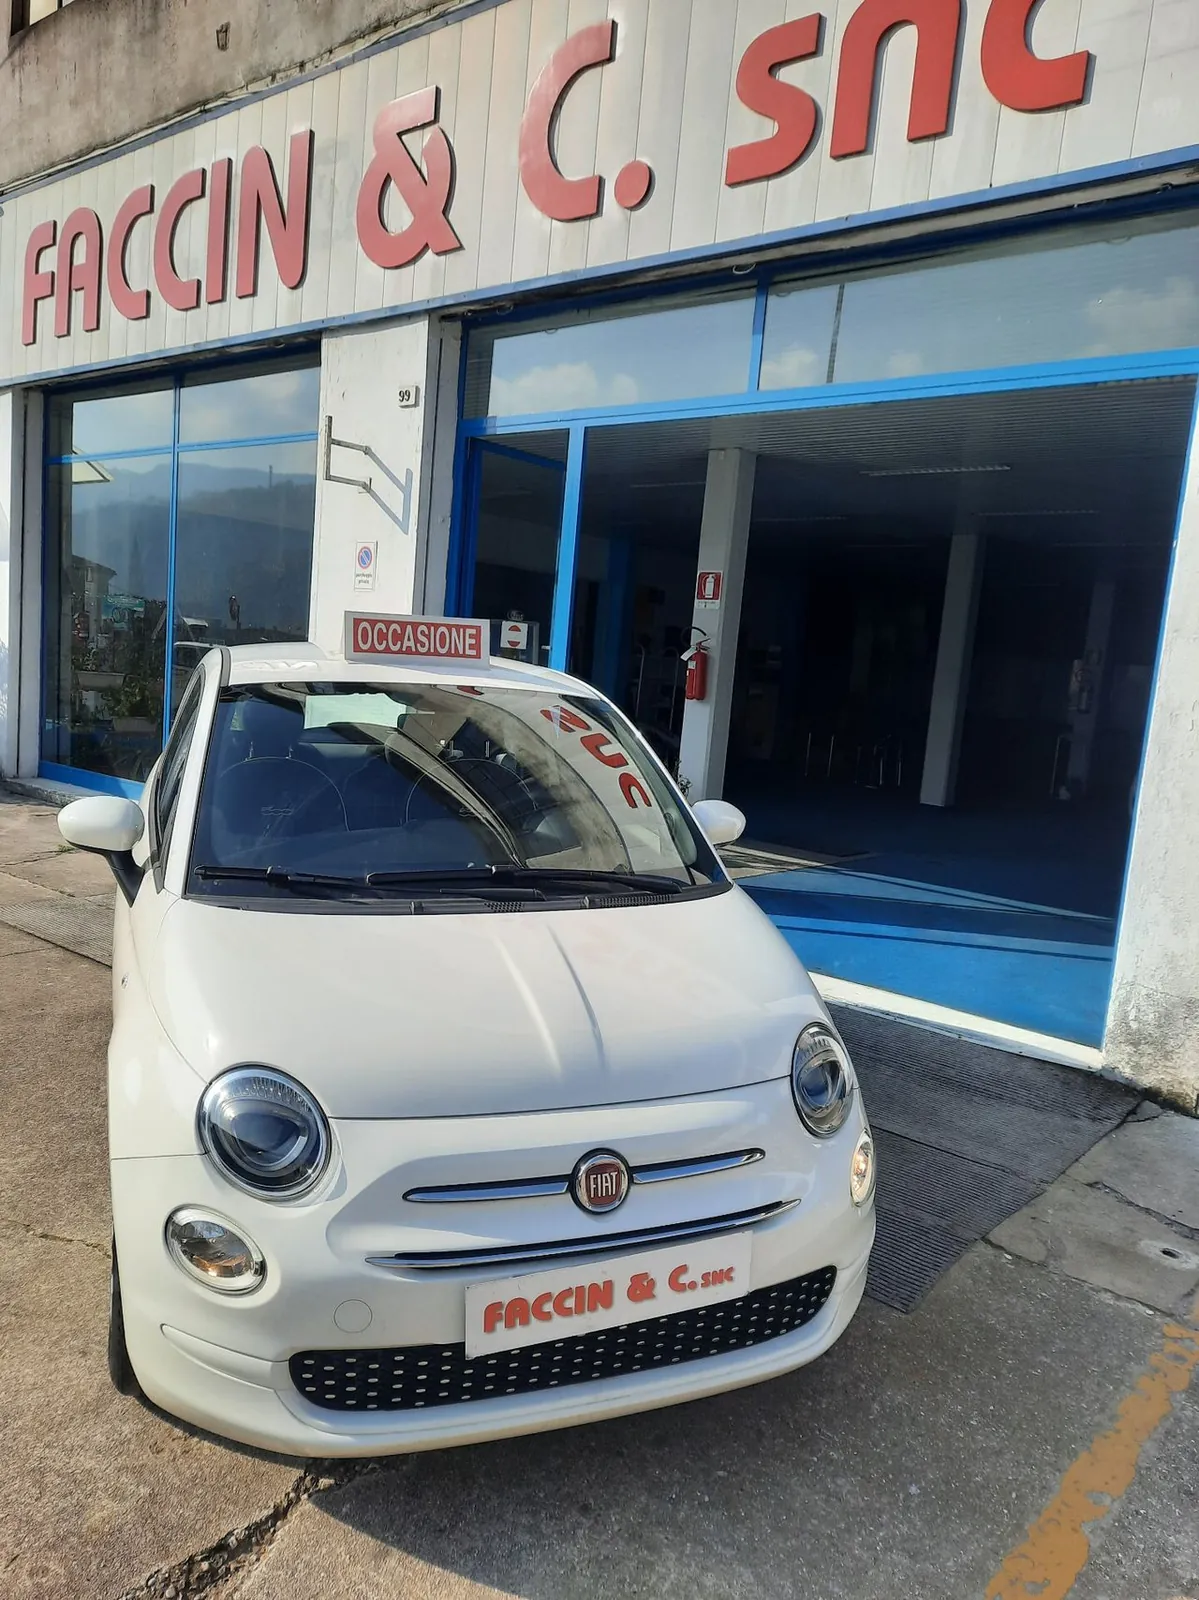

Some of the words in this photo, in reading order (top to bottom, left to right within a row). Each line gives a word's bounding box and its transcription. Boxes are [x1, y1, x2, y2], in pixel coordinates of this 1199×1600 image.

[22, 128, 314, 346] FACCIN
[356, 85, 462, 269] &
[518, 19, 652, 221] C.
[398, 390, 411, 402] 99
[357, 621, 477, 655] OCCASIONE
[590, 1171, 618, 1198] FIAT
[483, 1279, 613, 1333] FACCIN
[627, 1272, 656, 1302] &
